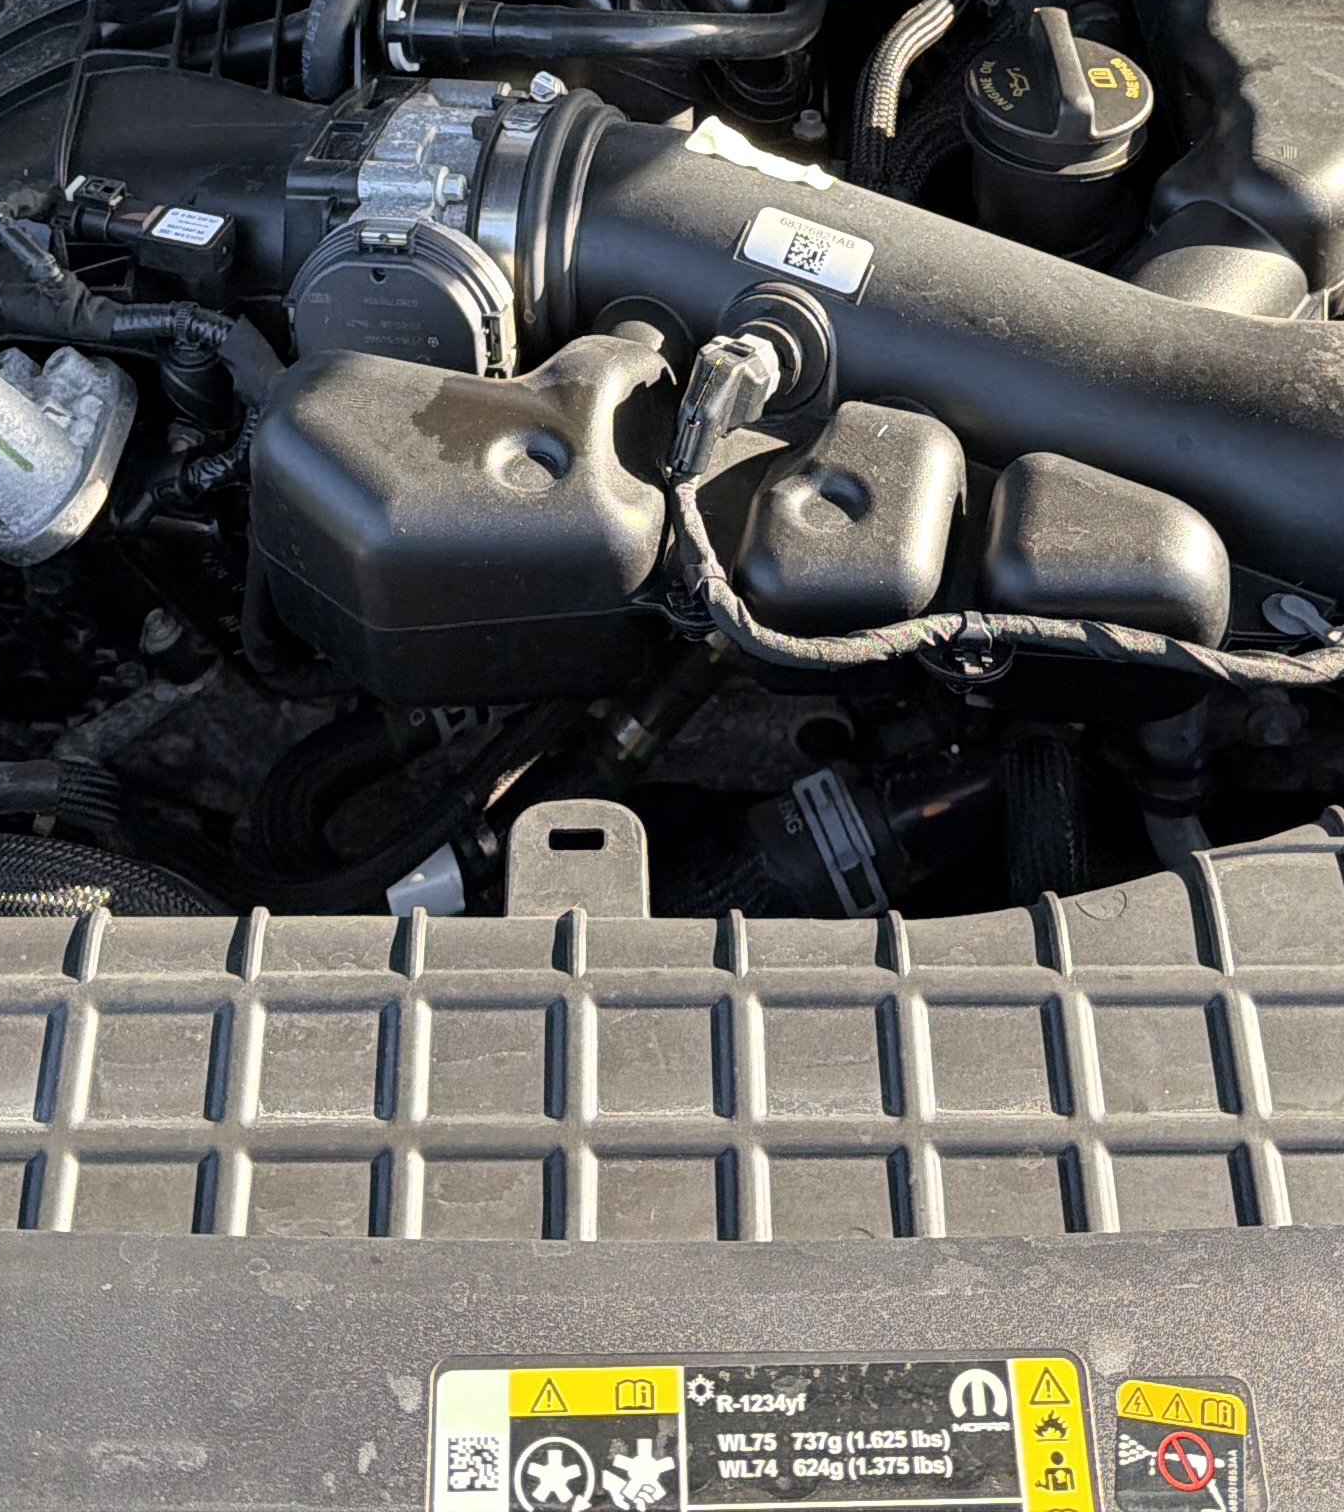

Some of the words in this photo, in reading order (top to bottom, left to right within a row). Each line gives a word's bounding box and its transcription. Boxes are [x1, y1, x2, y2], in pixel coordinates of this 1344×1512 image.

[979, 60, 997, 74] OIL
[979, 77, 1014, 111] ENGINE
[780, 217, 855, 249] 68376821AB
[716, 1393, 807, 1416] R-1234yf
[717, 1433, 777, 1453] WL75
[791, 1432, 843, 1454] 737g
[847, 1430, 907, 1454] (1.625
[911, 1429, 951, 1451] lbs)
[718, 1459, 778, 1479] WL74
[792, 1457, 844, 1480] 624g
[848, 1456, 910, 1479] (1.375
[914, 1455, 953, 1478] lbs)
